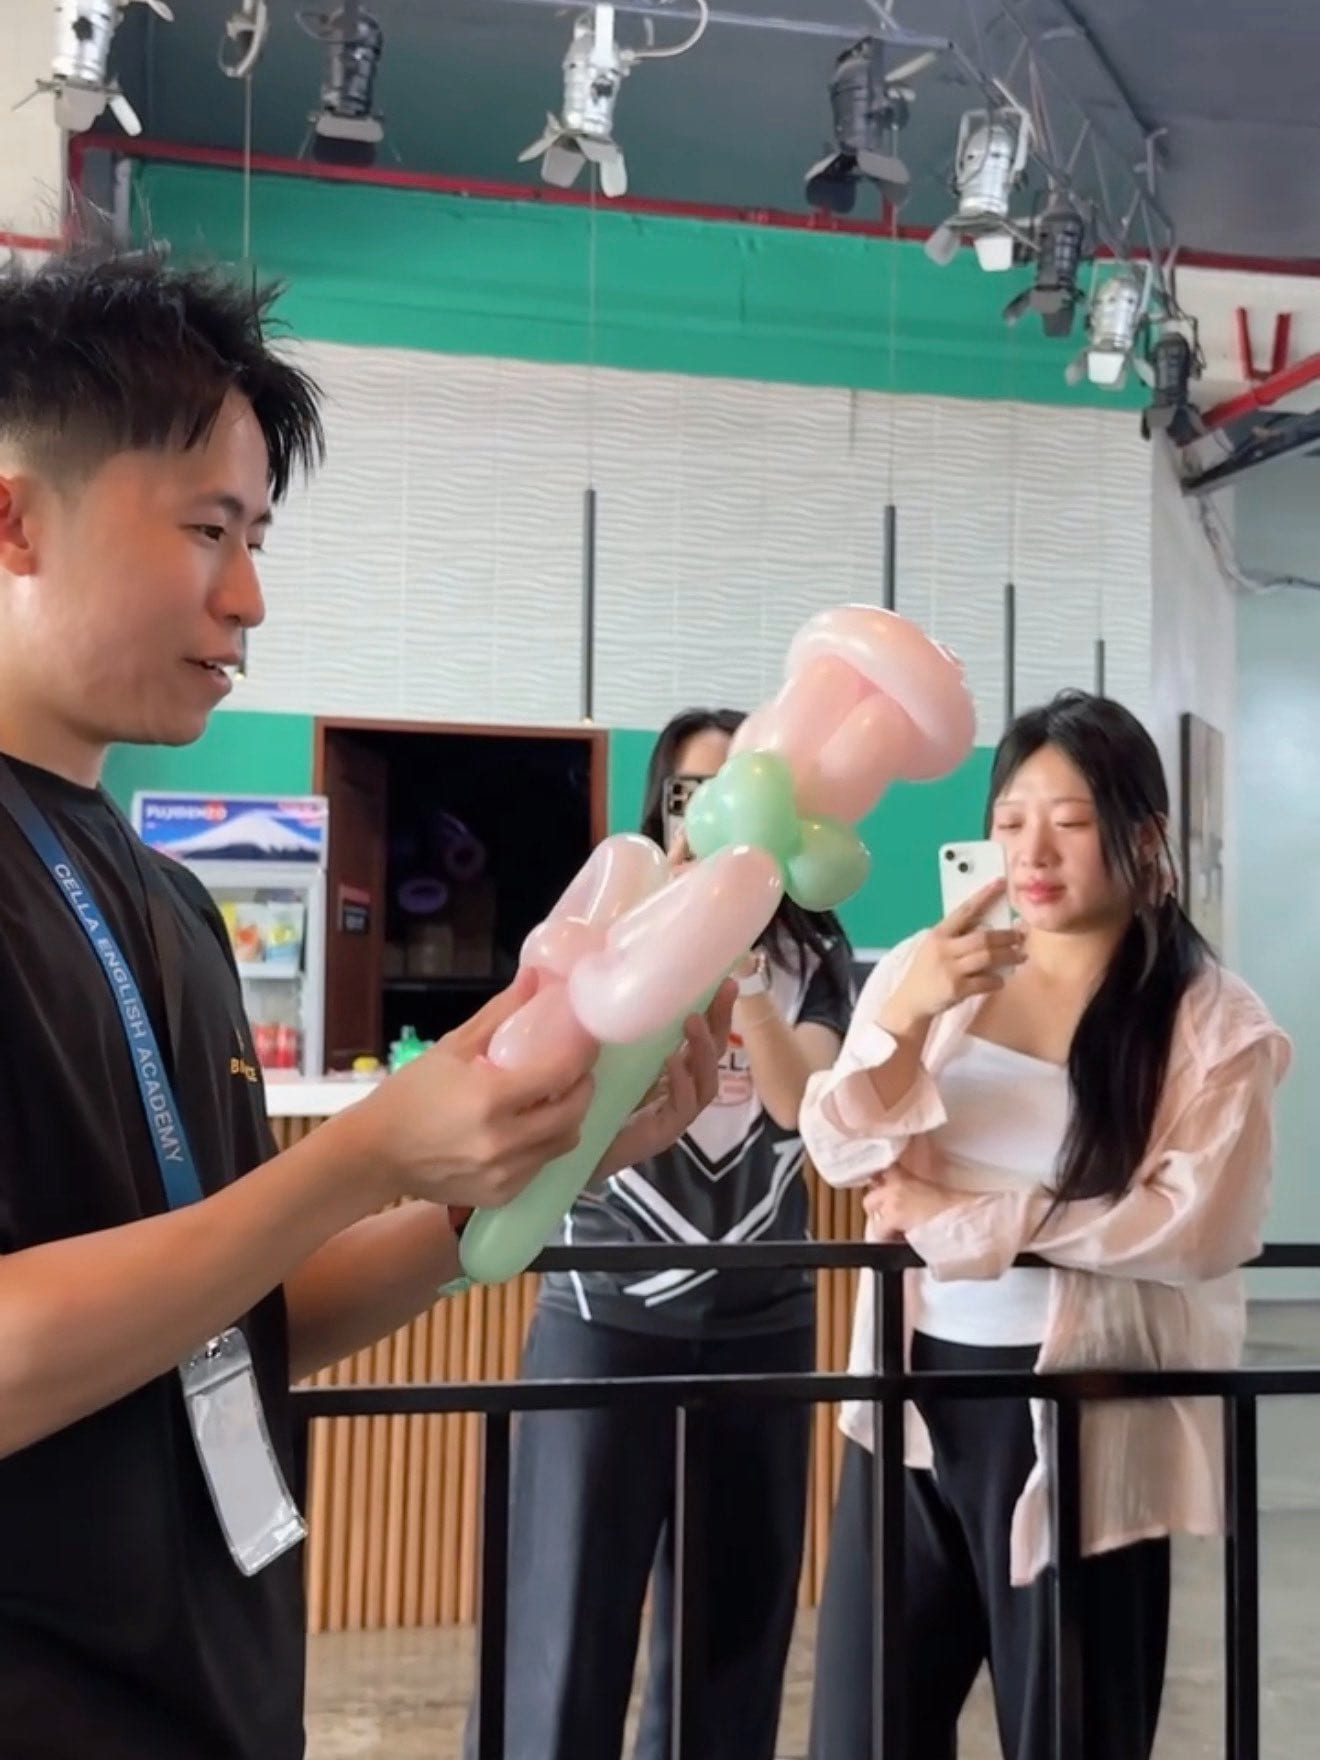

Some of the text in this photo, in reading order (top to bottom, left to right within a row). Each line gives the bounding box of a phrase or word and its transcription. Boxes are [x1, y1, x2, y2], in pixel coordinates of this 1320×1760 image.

[54, 863, 184, 1163] CELLA ENGLISH ACADEMY
